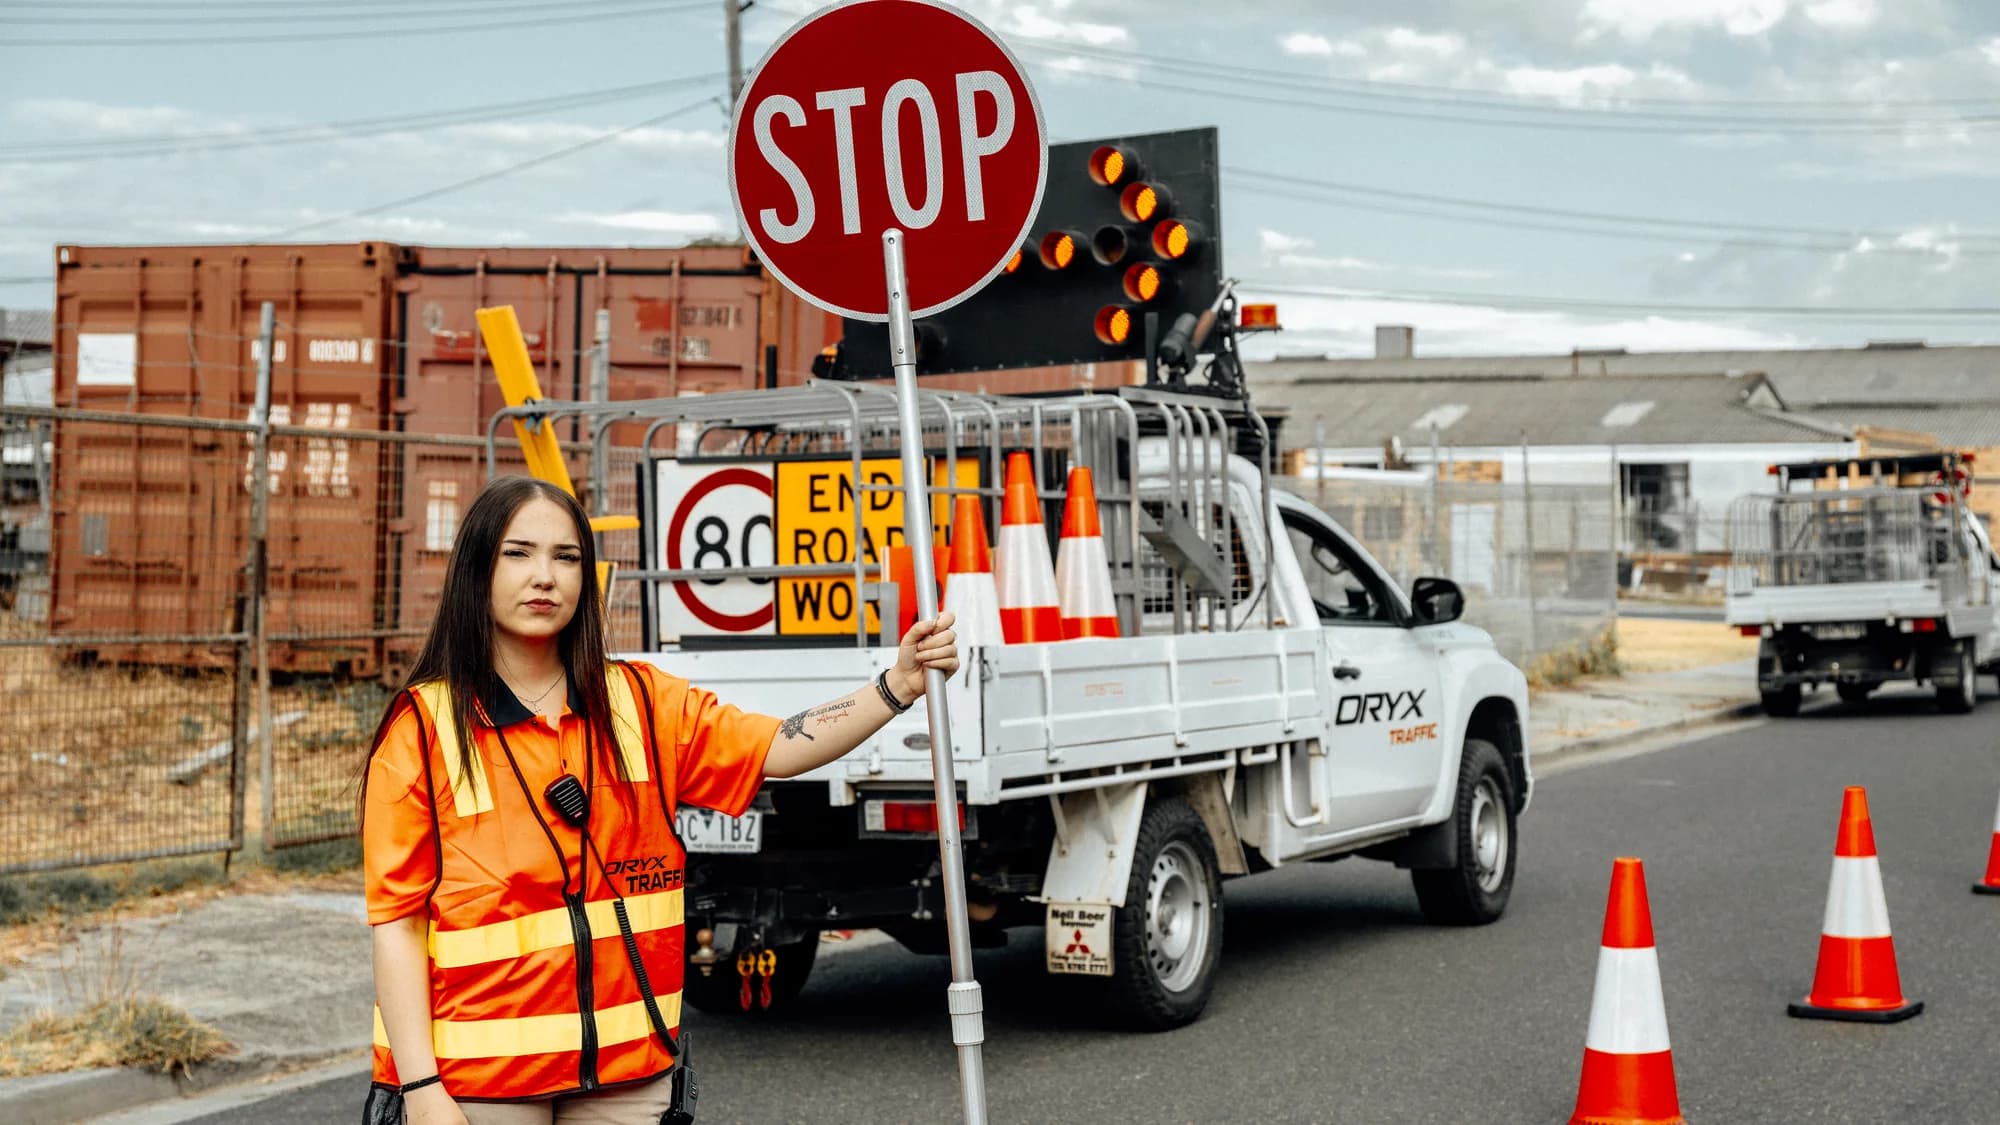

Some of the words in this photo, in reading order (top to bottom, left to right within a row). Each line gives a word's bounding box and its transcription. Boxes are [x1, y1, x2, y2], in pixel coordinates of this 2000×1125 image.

[753, 70, 1016, 244] STOP
[809, 472, 895, 512] END
[693, 514, 775, 586] 80
[1335, 688, 1427, 725] ORYX
[1389, 722, 1438, 745] TRAFFIC
[720, 815, 756, 842] 1BZ
[605, 855, 668, 876] ORYX
